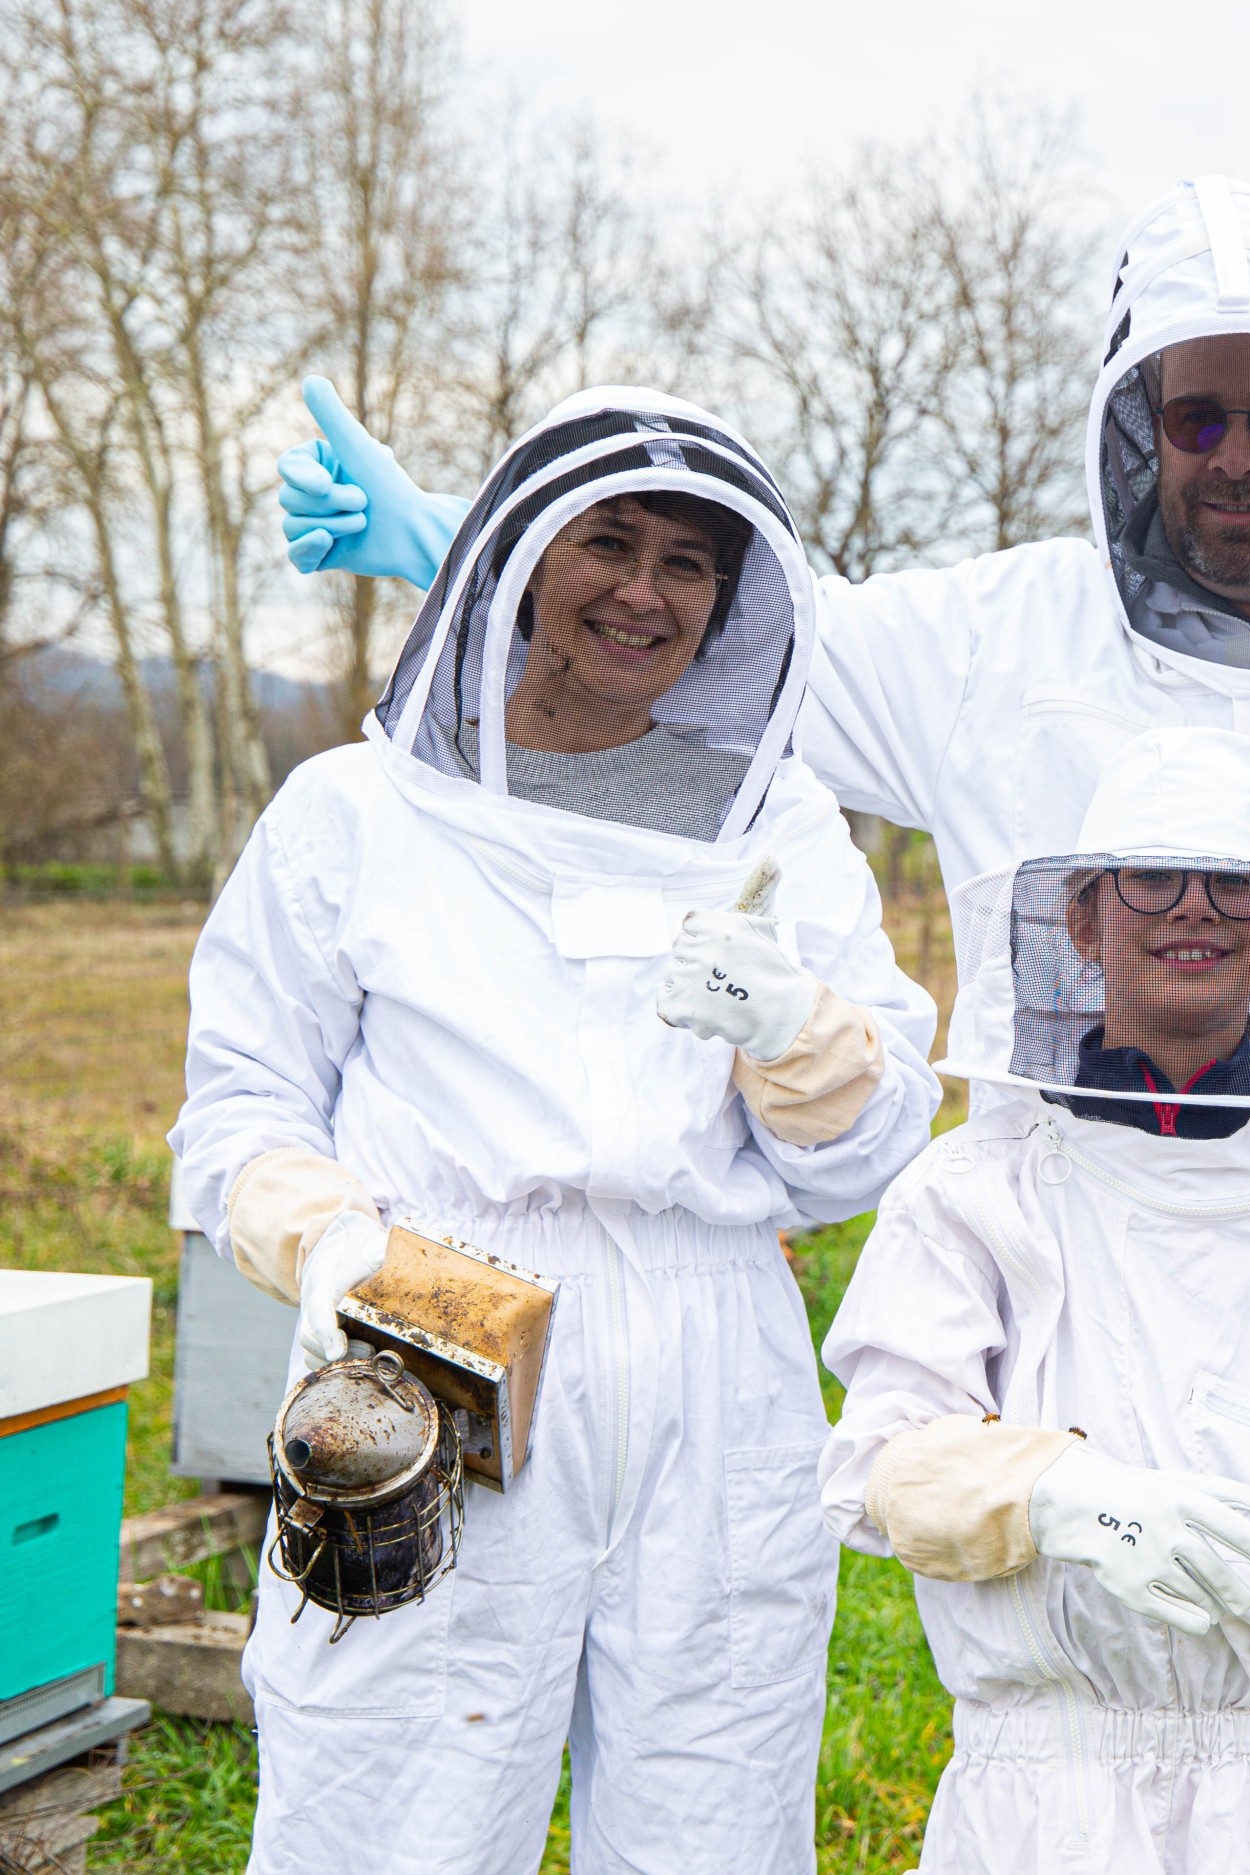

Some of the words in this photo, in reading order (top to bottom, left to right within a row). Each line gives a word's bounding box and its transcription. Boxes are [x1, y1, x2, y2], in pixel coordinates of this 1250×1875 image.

[706, 967, 727, 992] CE
[725, 983, 749, 1001] 5
[1097, 1513, 1121, 1531] 5
[1120, 1521, 1143, 1547] CE
